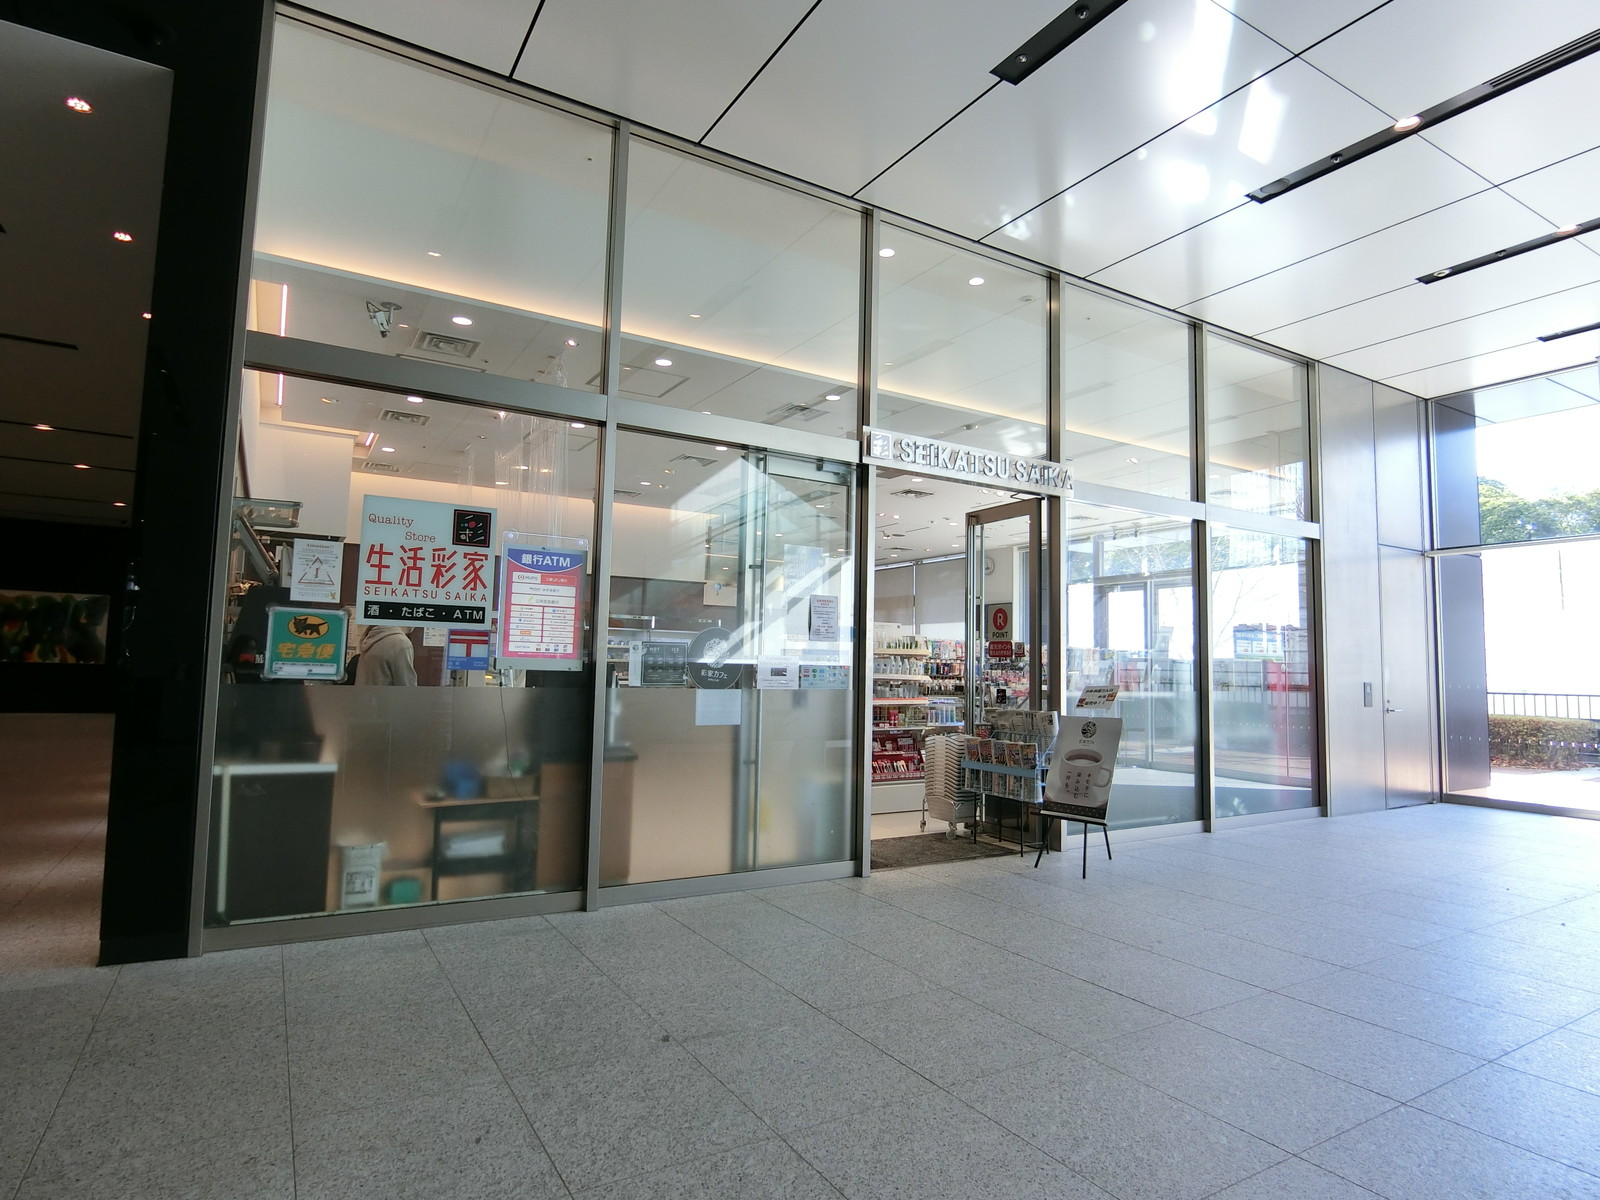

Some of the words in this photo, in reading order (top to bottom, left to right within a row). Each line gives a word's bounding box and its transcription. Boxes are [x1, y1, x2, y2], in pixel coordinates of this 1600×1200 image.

[899, 438, 1010, 479] SEIKATSU
[1015, 459, 1074, 490] SAIKA
[368, 513, 414, 528] Quality
[405, 531, 436, 543] Store
[364, 543, 489, 592] 生活彩家
[521, 553, 571, 568] 銀行ATM
[364, 586, 438, 599] SEIKATSU
[445, 591, 488, 602] SAIKA
[997, 613, 1005, 627] R
[992, 631, 1009, 639] POINT
[277, 642, 336, 660] 宅急便
